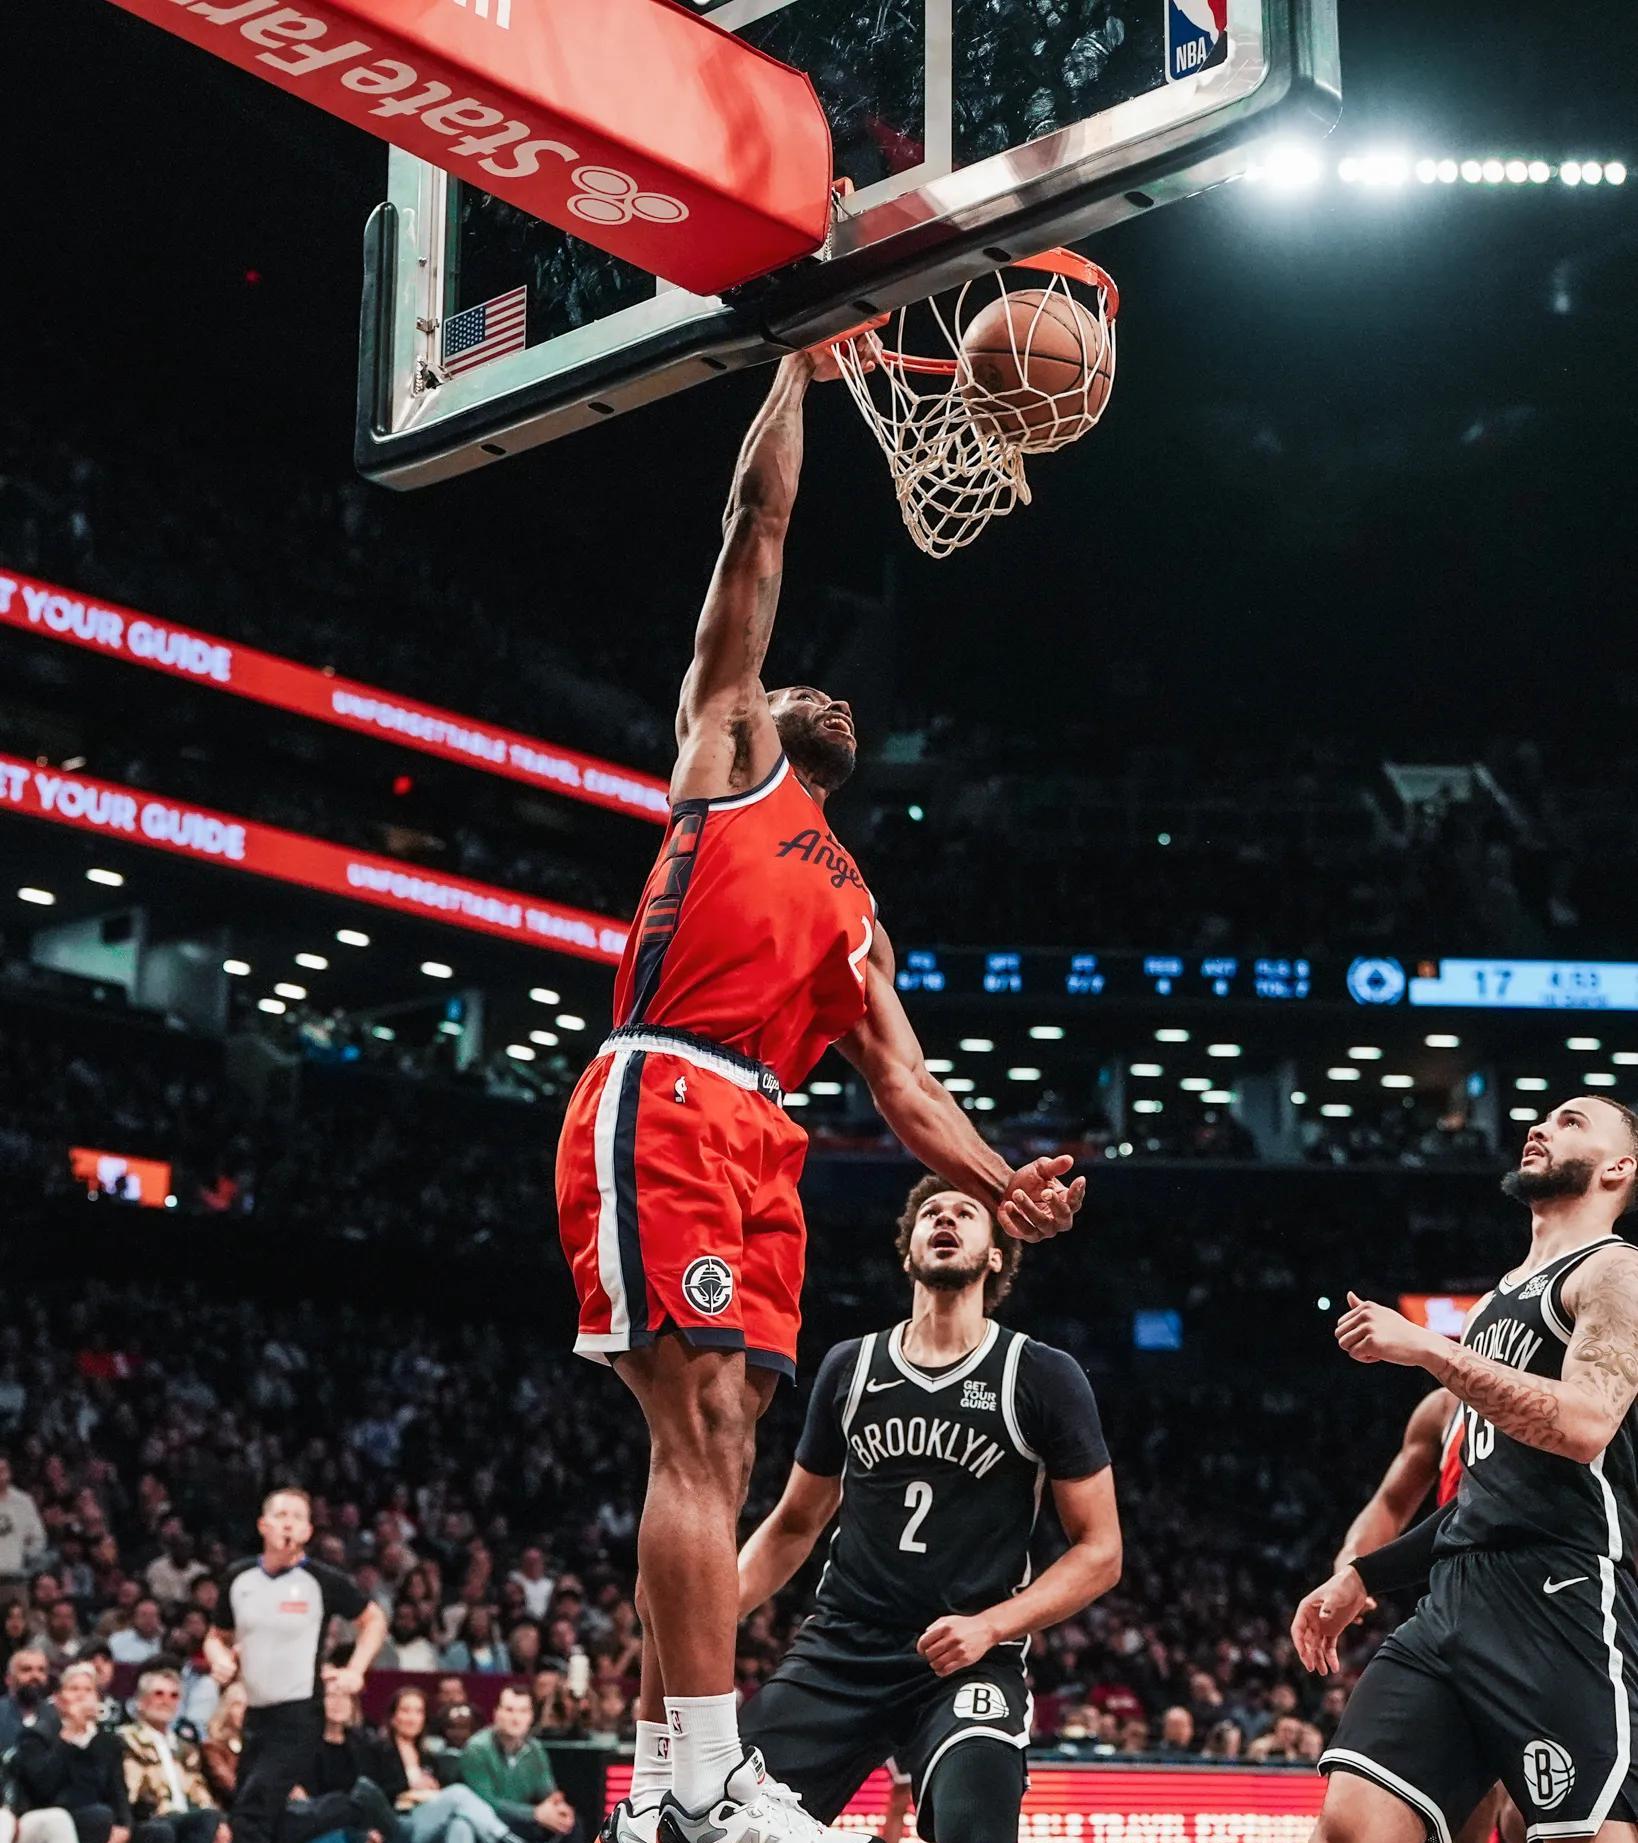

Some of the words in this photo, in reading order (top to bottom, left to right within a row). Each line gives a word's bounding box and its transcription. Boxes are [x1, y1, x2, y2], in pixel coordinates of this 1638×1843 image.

[170, 0, 372, 76] Far
[1176, 37, 1207, 73] NBA
[340, 59, 580, 177] State
[22, 586, 124, 648] YOUR
[128, 621, 232, 682] GUIDE
[35, 773, 137, 832] YOUR
[141, 803, 245, 860] GUIDE
[1476, 969, 1513, 998] 17
[960, 1398, 997, 1412] GUIDE
[963, 1380, 987, 1391] GET
[963, 1389, 997, 1402] YOUR
[850, 1416, 1005, 1480] BROOKLYN
[899, 1481, 933, 1553] 2
[972, 1688, 991, 1714] B
[1534, 1748, 1554, 1800] B
